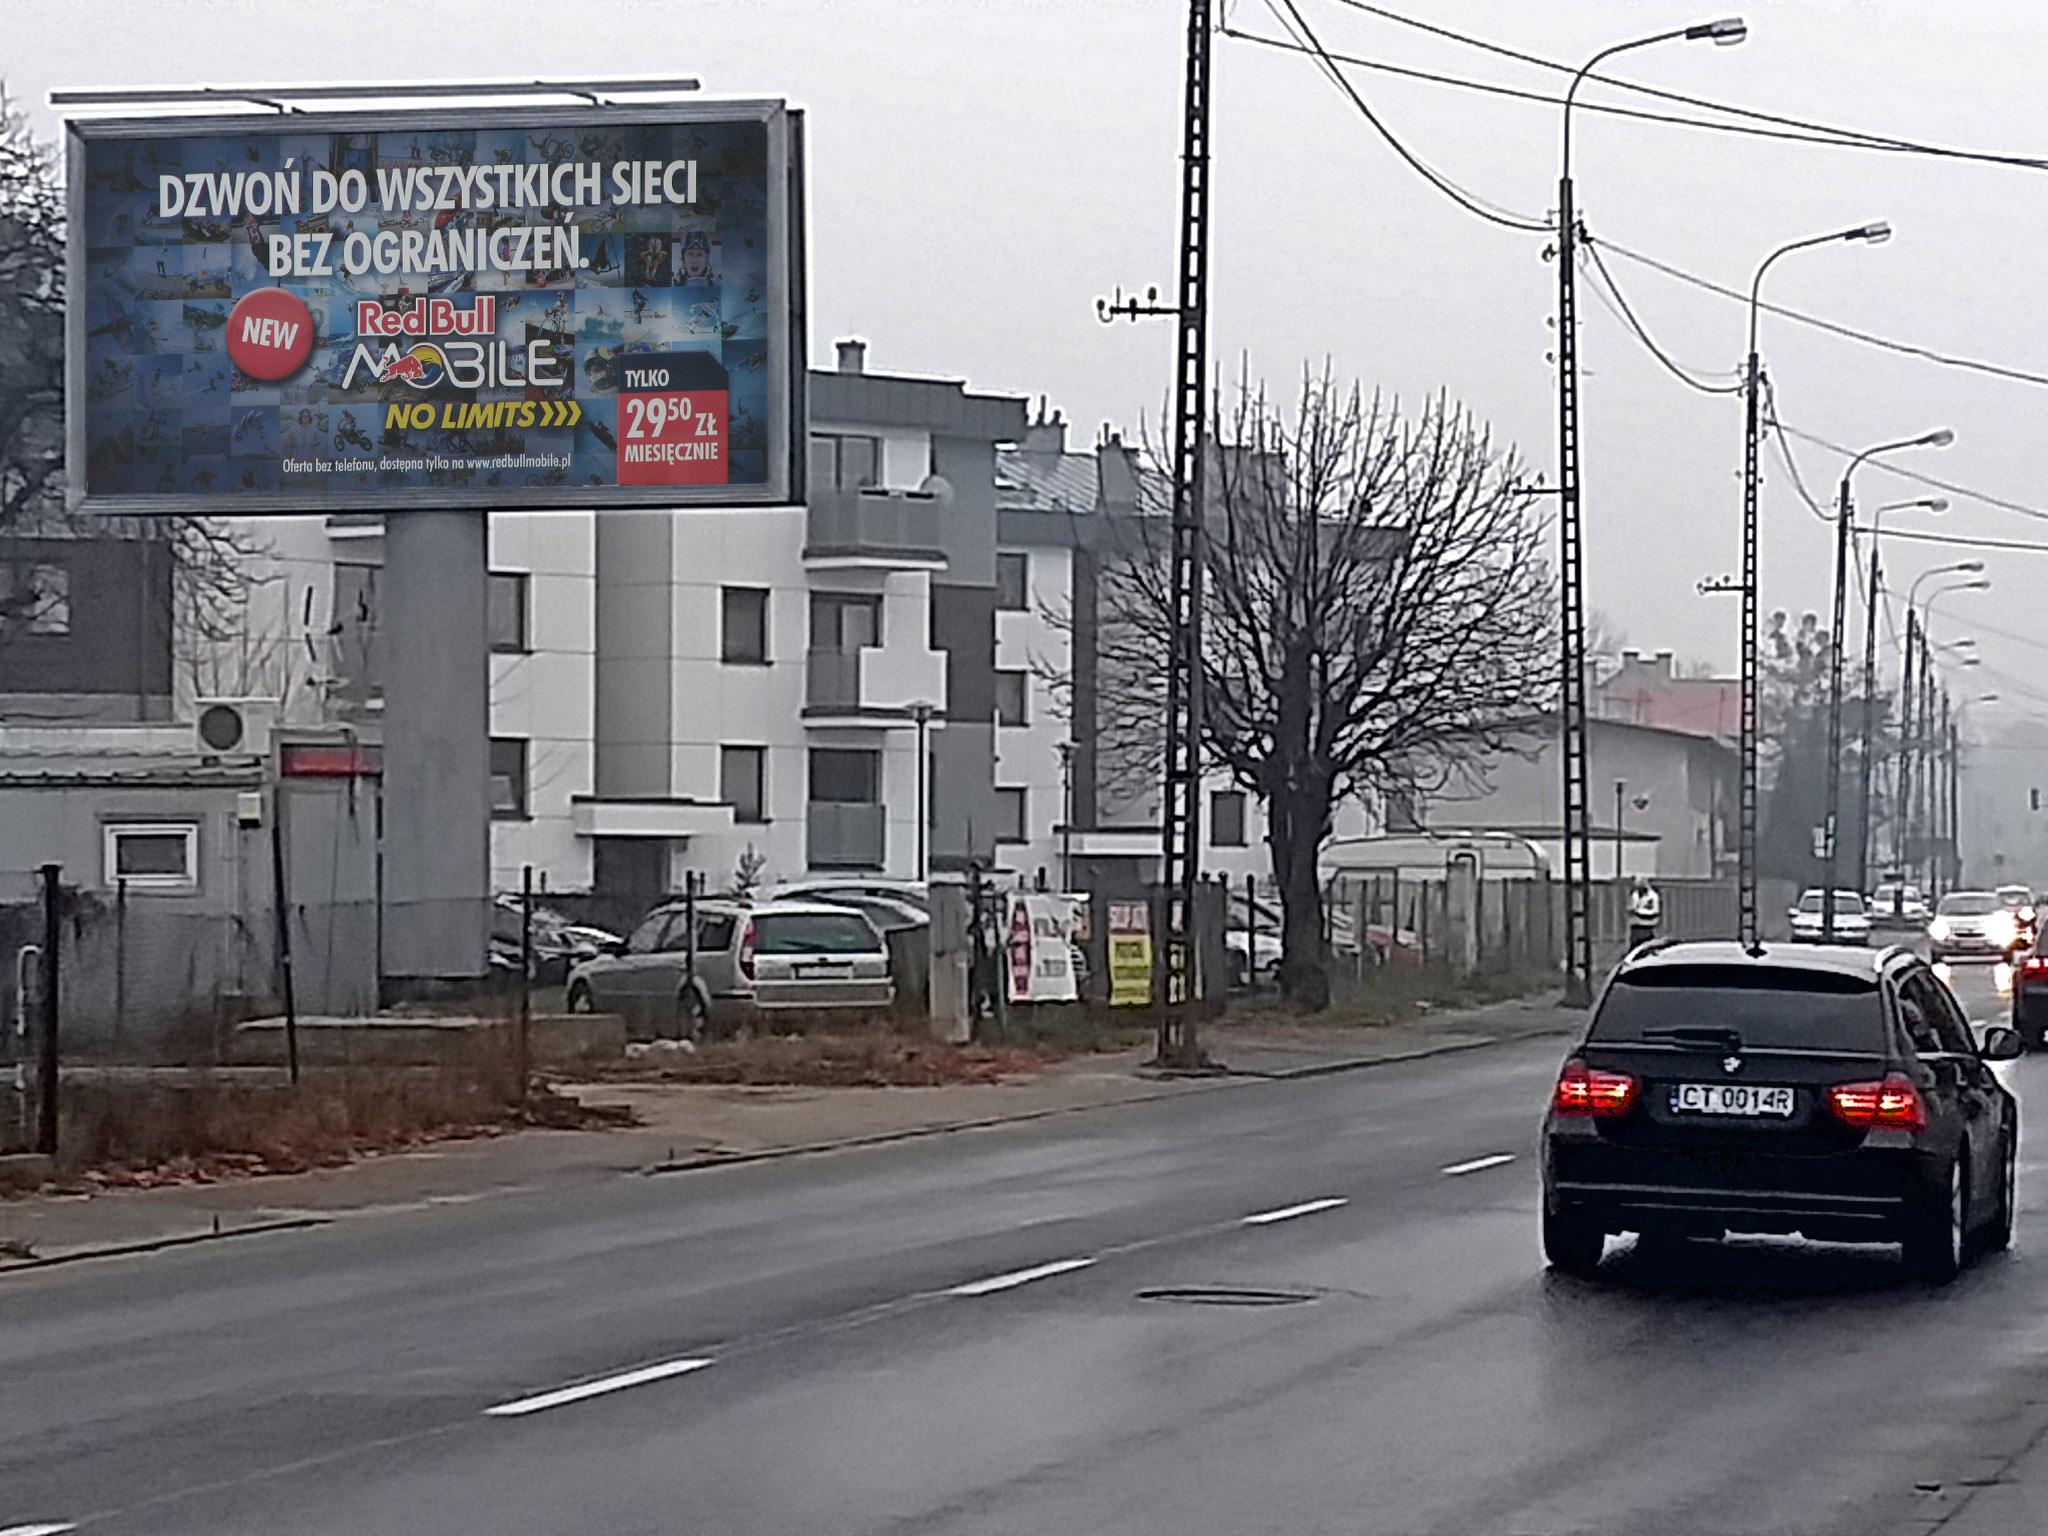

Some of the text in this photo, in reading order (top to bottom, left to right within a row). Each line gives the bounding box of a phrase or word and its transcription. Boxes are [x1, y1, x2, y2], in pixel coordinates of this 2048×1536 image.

[159, 158, 697, 218] DZWOŃ DO WSZYSTKICH SIECI
[268, 211, 590, 277] BEZ OGRANICZEŃ.
[357, 295, 496, 336] Red Bull
[241, 316, 299, 351] NEW
[341, 339, 565, 390] MOBILE
[625, 368, 670, 388] TYLKO
[384, 401, 536, 431] NO LIMITS
[694, 412, 718, 436] ZŁ
[282, 452, 571, 473] Oferta bez telefonu, dostępna tylko na www.redbullmobile.pl
[624, 442, 718, 465] MIESIĘCZNIE
[1684, 1086, 1790, 1110] CT 0014R
